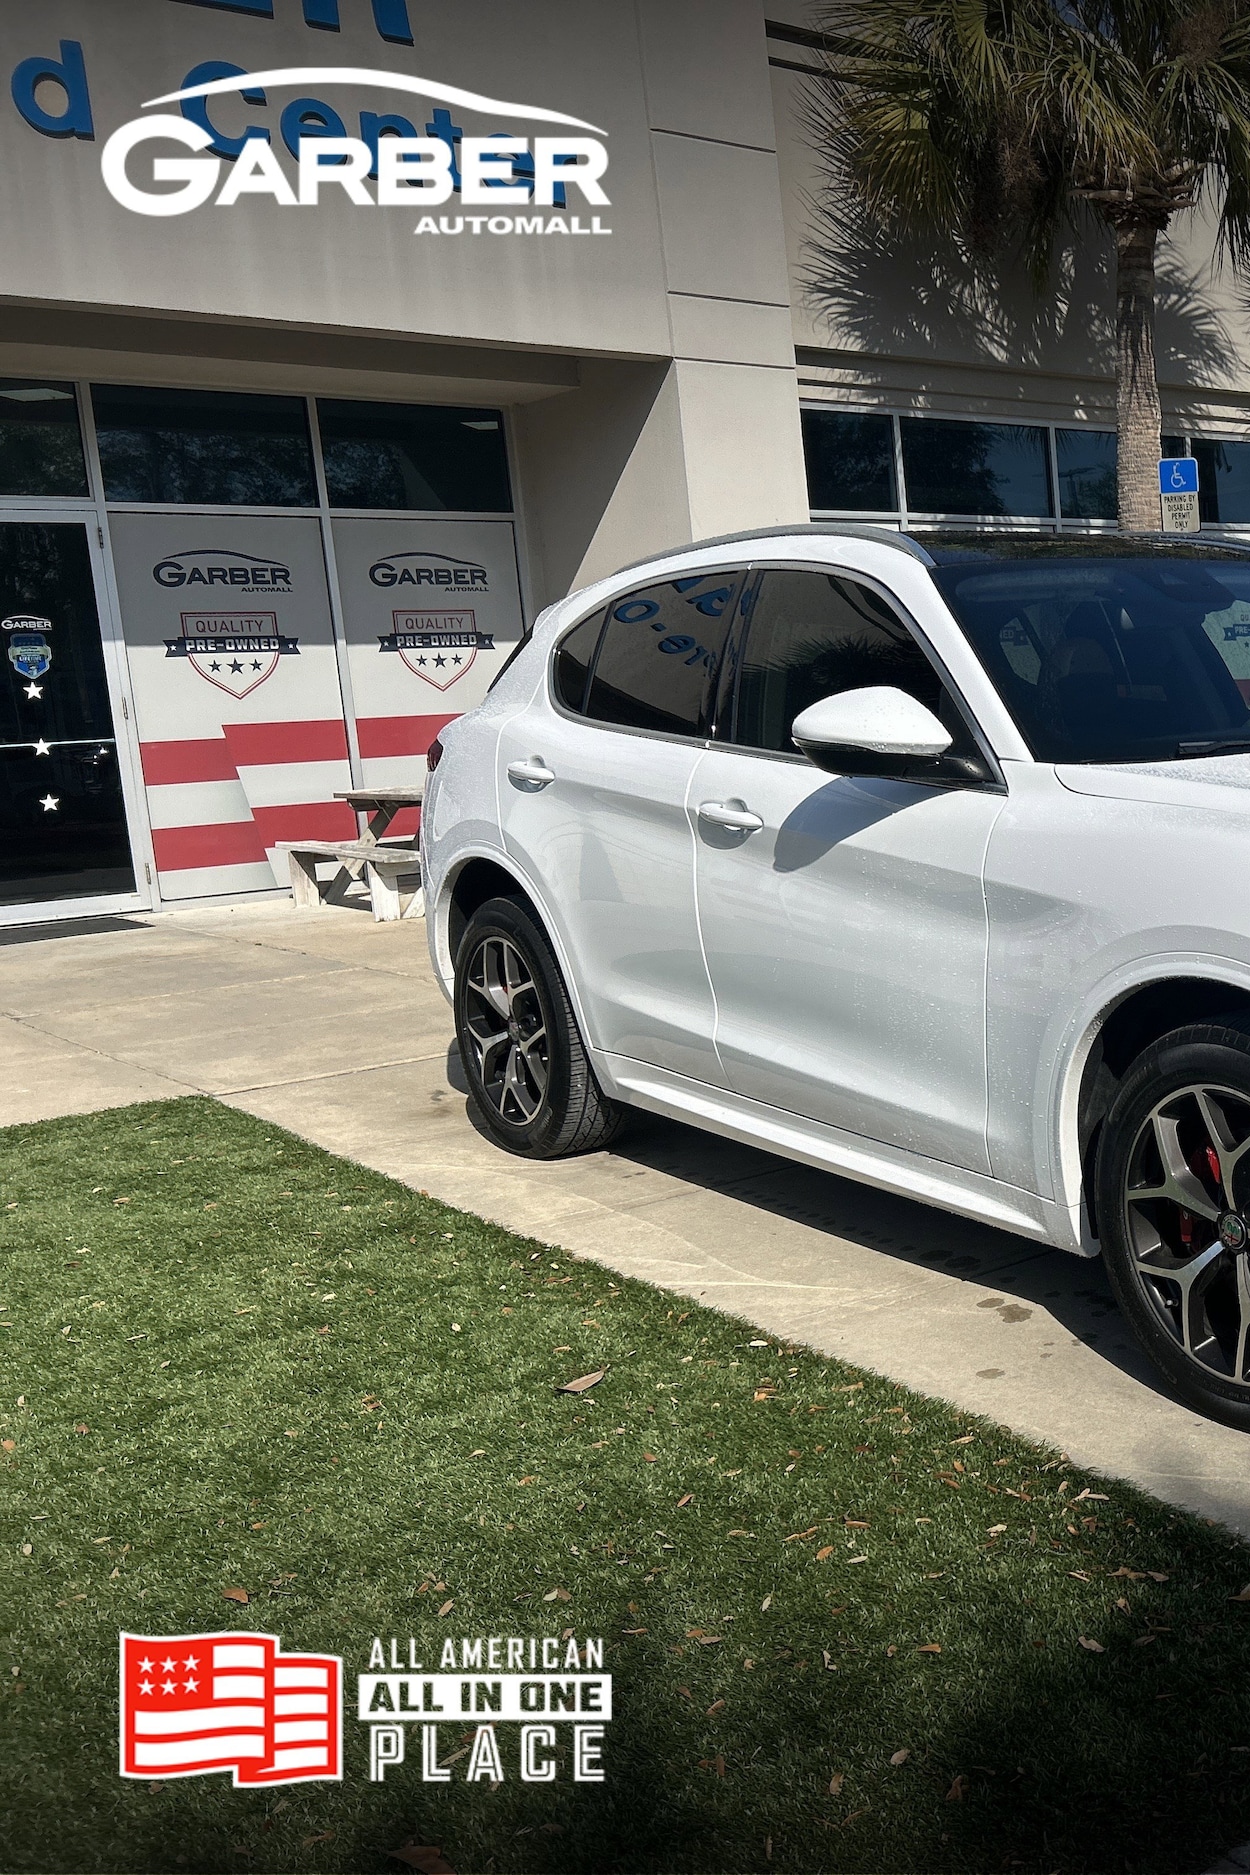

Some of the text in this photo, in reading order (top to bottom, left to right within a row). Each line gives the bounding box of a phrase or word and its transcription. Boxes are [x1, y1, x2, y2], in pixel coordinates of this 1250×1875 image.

[1164, 495, 1187, 504] PARKING
[1167, 503, 1193, 512] DISABLED
[1171, 512, 1190, 520] PERMIT
[153, 561, 293, 588] GARBER
[369, 562, 489, 588] GARBER
[1, 619, 52, 630] GARBER
[195, 619, 264, 633] QUALITY
[405, 617, 464, 630] QUALITY
[185, 638, 281, 652] PRE-OWNED
[396, 634, 478, 648] PRE-OWNED
